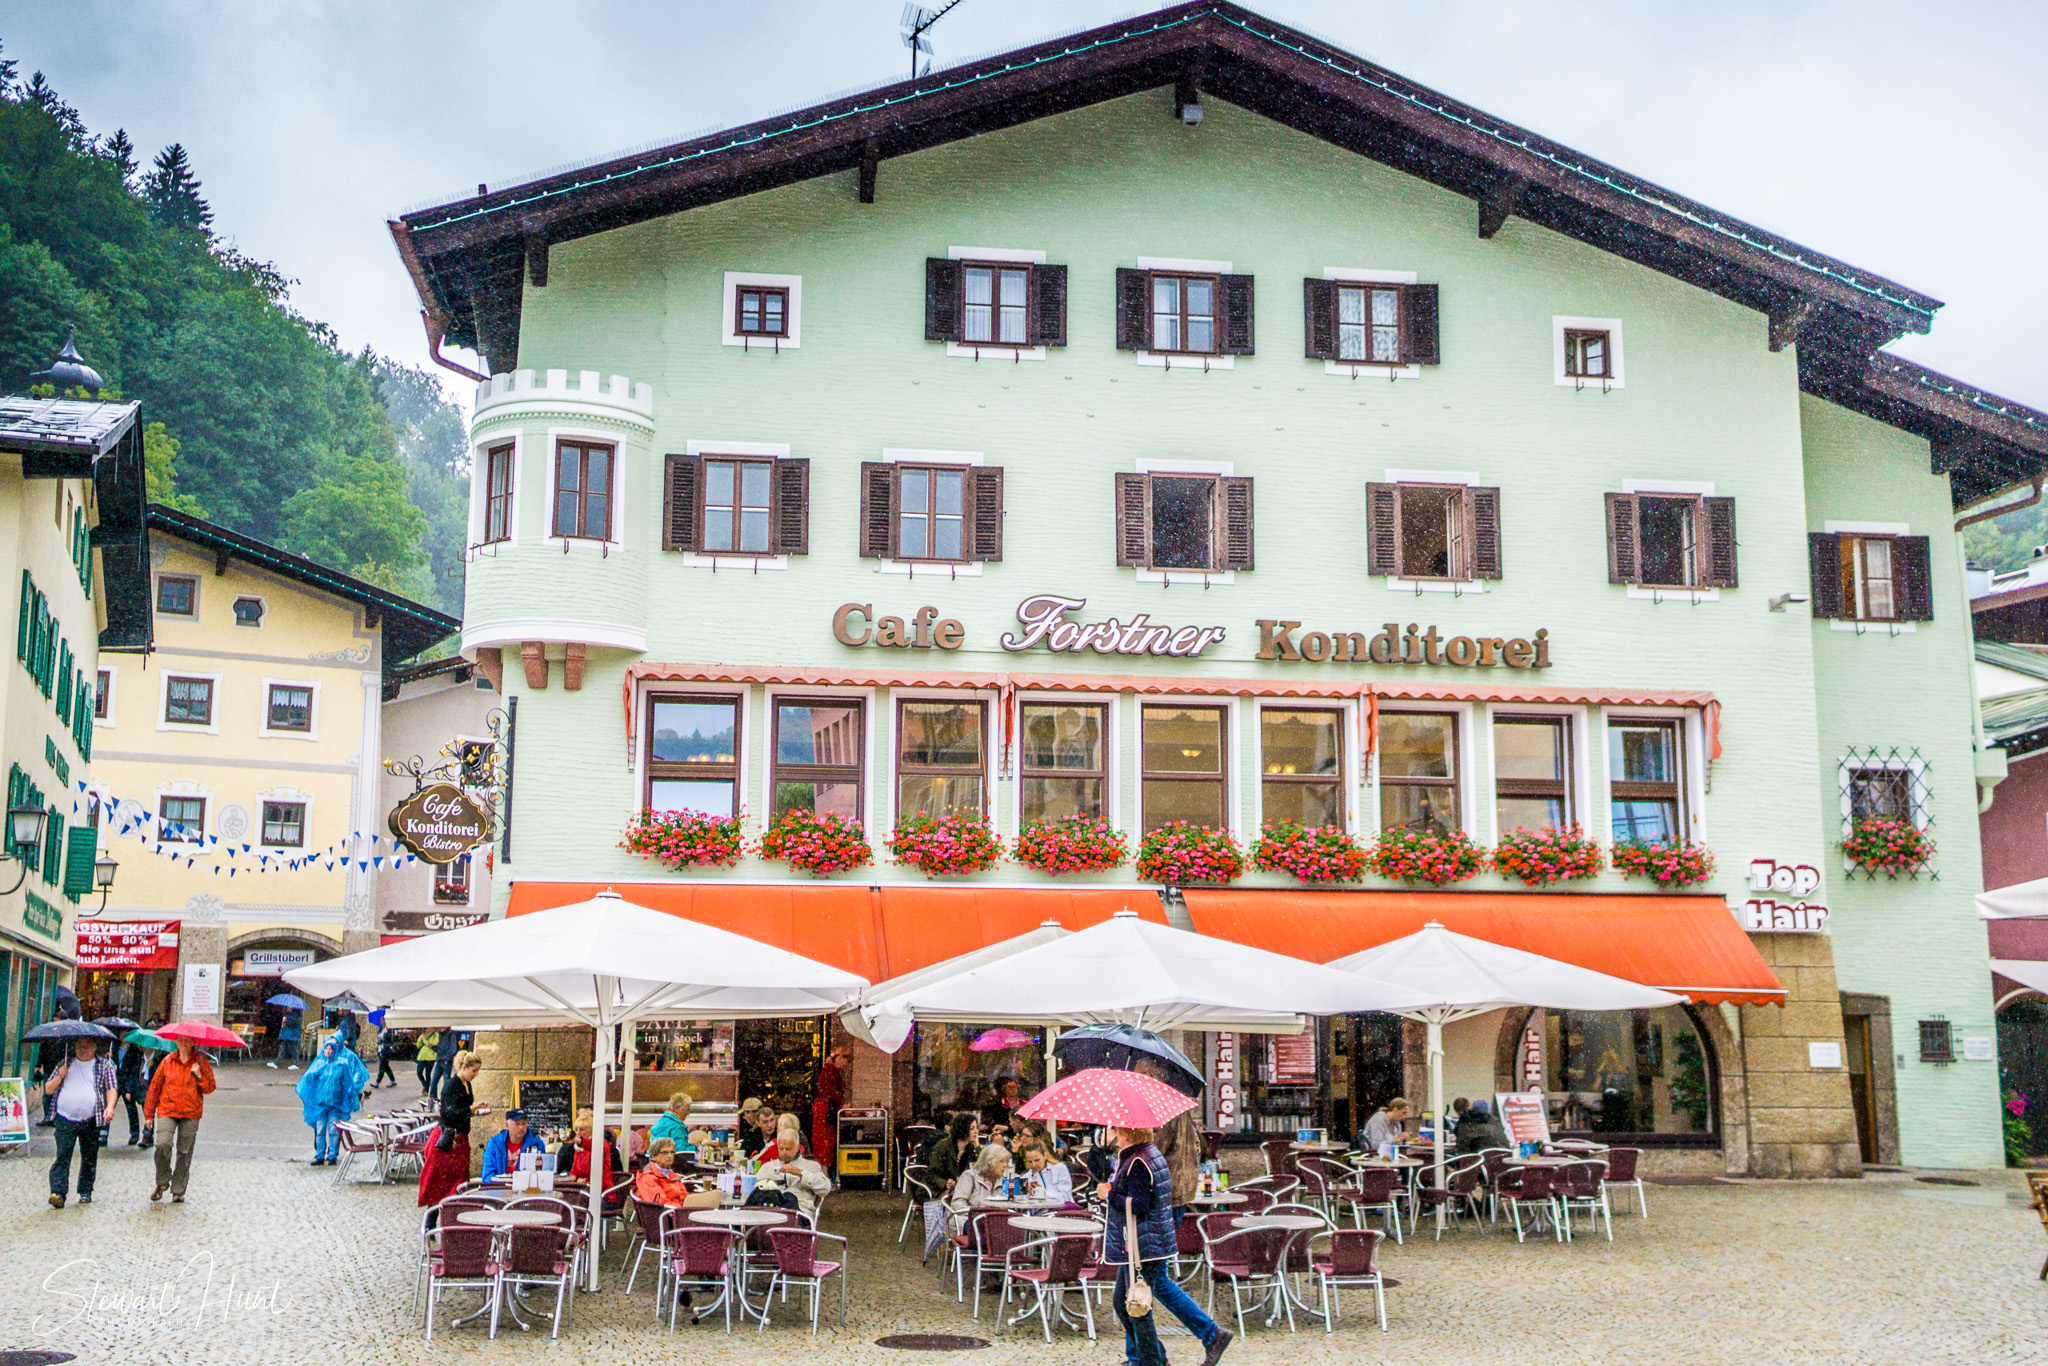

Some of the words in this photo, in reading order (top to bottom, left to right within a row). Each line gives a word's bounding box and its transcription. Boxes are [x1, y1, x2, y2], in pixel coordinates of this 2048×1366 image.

[832, 602, 966, 650] Cafe
[1000, 594, 1226, 657] Forstner
[1255, 619, 1553, 669] Konditorei
[423, 794, 463, 821] Cafe
[406, 819, 479, 837] Konditorei
[423, 835, 463, 850] Bistro
[1747, 858, 1821, 896] Top
[1744, 899, 1829, 930] Hair
[79, 944, 100, 954] Sie
[103, 946, 126, 954] uns
[129, 945, 156, 955] aus!
[101, 955, 140, 964] Laden.
[250, 952, 309, 963] Grillstüberl
[644, 1032, 659, 1043] im
[663, 1034, 671, 1043] 1.
[673, 1032, 703, 1043] Stock
[1215, 1031, 1234, 1079] Hair
[1524, 1027, 1541, 1081] Hair
[1216, 1083, 1237, 1128] Top
